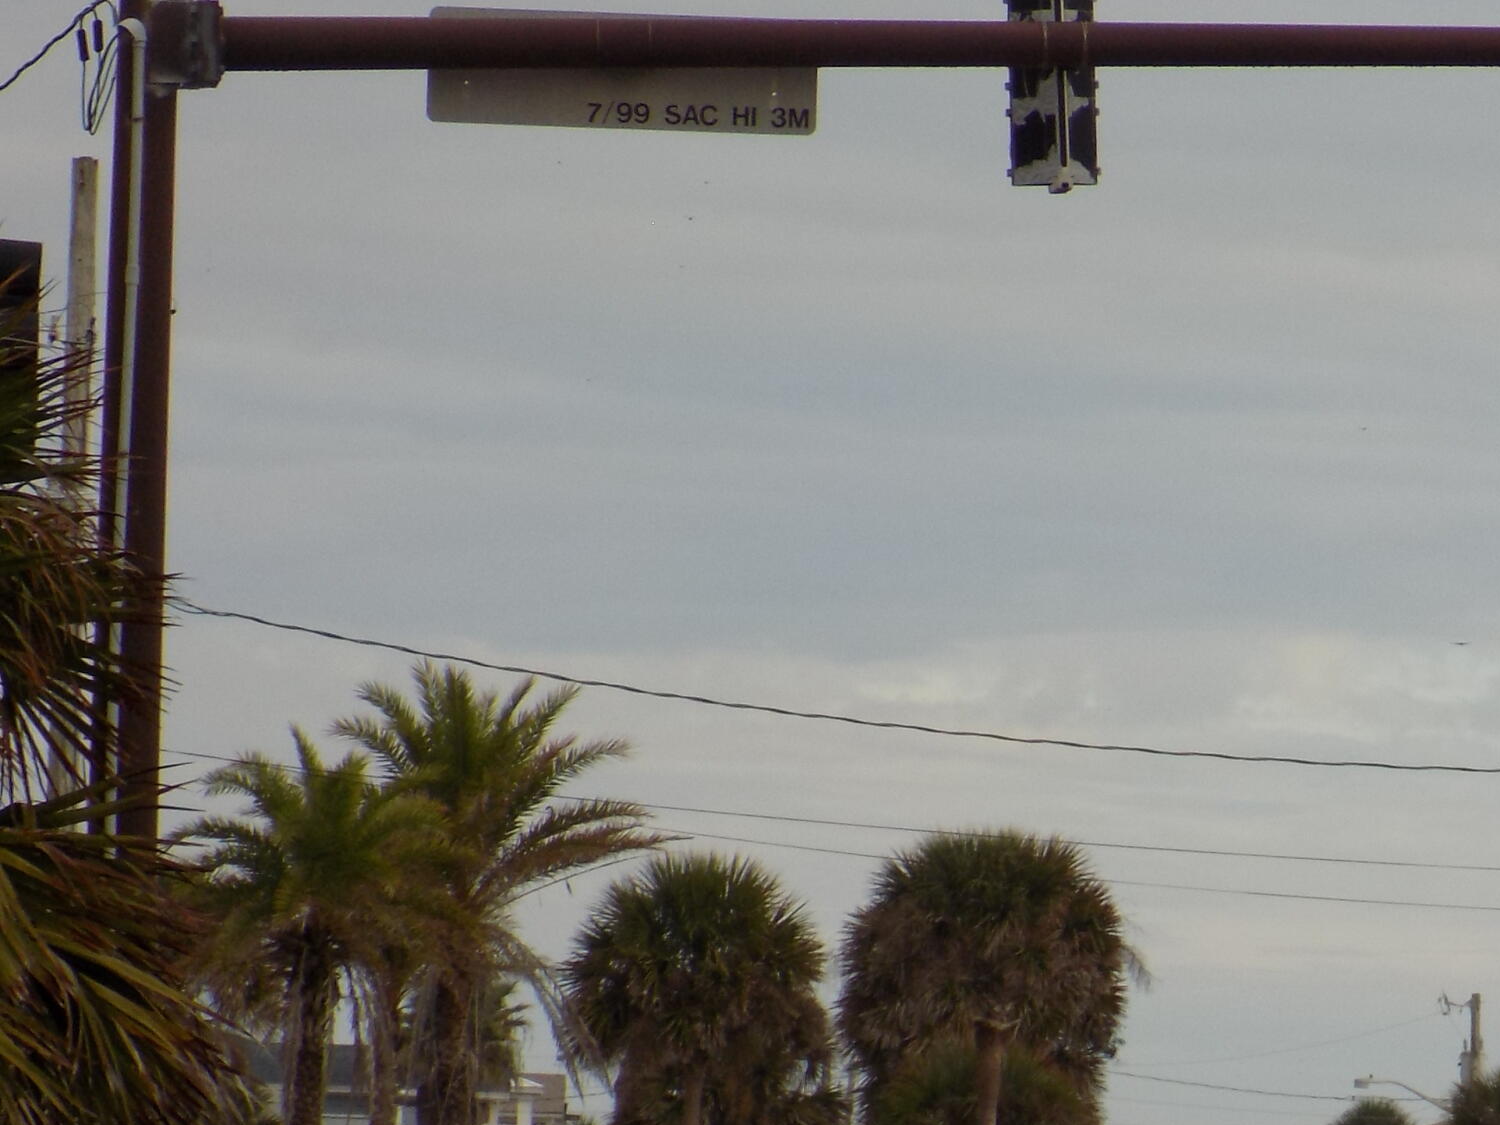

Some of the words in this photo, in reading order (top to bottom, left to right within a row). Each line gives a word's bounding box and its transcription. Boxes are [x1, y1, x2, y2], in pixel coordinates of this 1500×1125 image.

[586, 102, 650, 125] 7/99
[664, 104, 719, 127] SAC
[732, 106, 758, 127] HI
[771, 106, 810, 129] 3M
